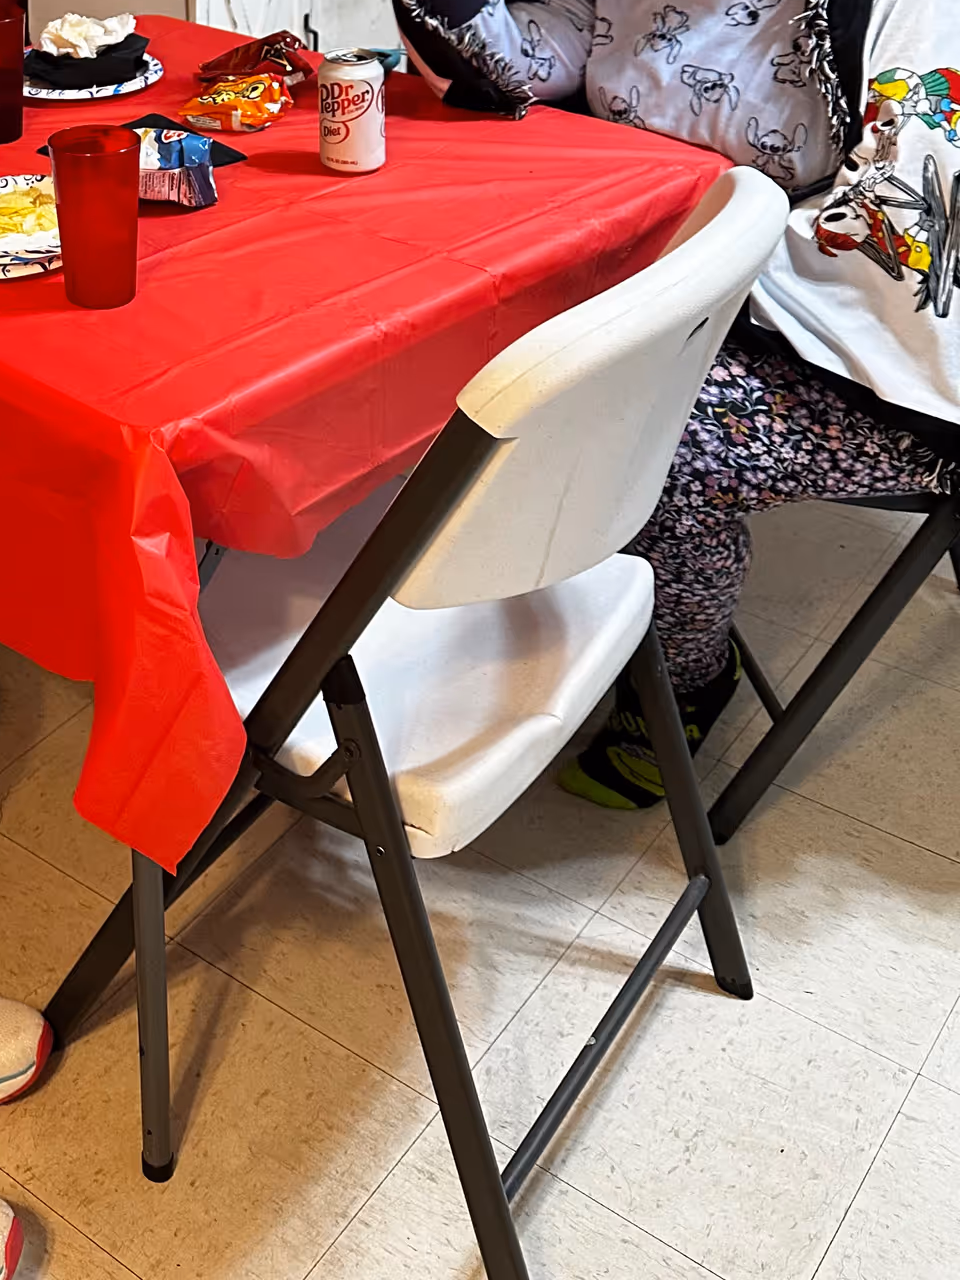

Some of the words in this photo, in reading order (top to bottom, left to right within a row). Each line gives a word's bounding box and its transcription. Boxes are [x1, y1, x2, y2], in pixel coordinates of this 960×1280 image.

[319, 83, 370, 117] Pepper
[330, 82, 354, 100] Dr
[323, 125, 341, 137] Diet
